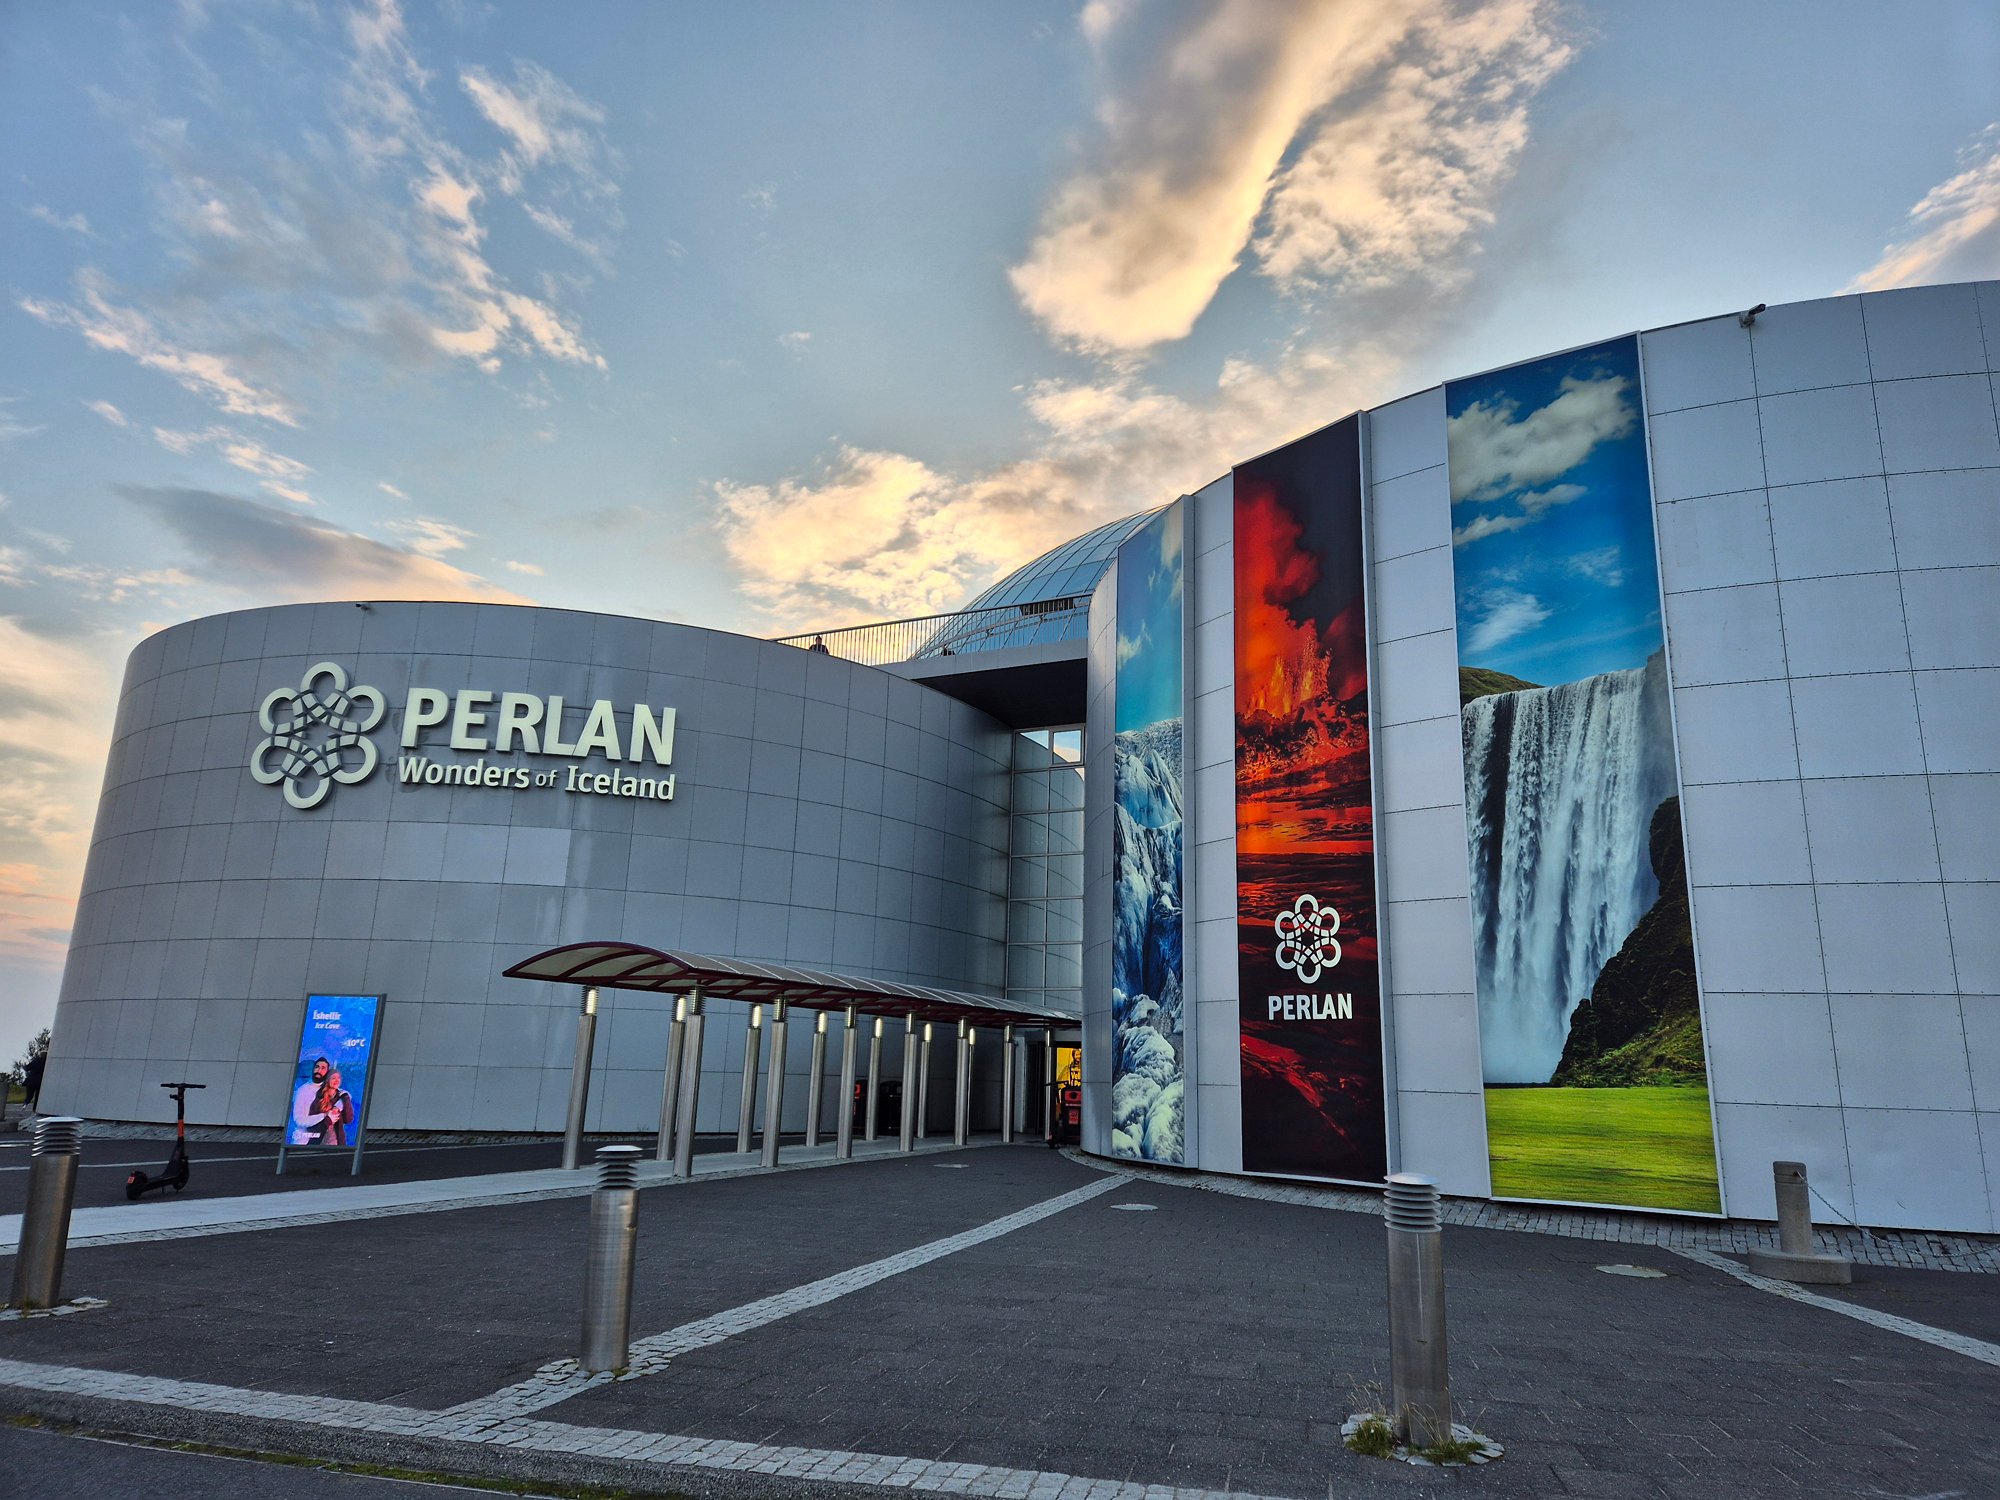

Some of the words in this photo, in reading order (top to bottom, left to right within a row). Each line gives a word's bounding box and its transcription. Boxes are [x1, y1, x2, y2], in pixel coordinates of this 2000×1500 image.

[400, 687, 677, 766] PERLAN
[399, 756, 530, 789] Wonders
[535, 769, 558, 788] of
[565, 765, 676, 801] Iceland
[1268, 993, 1353, 1021] PERLAN
